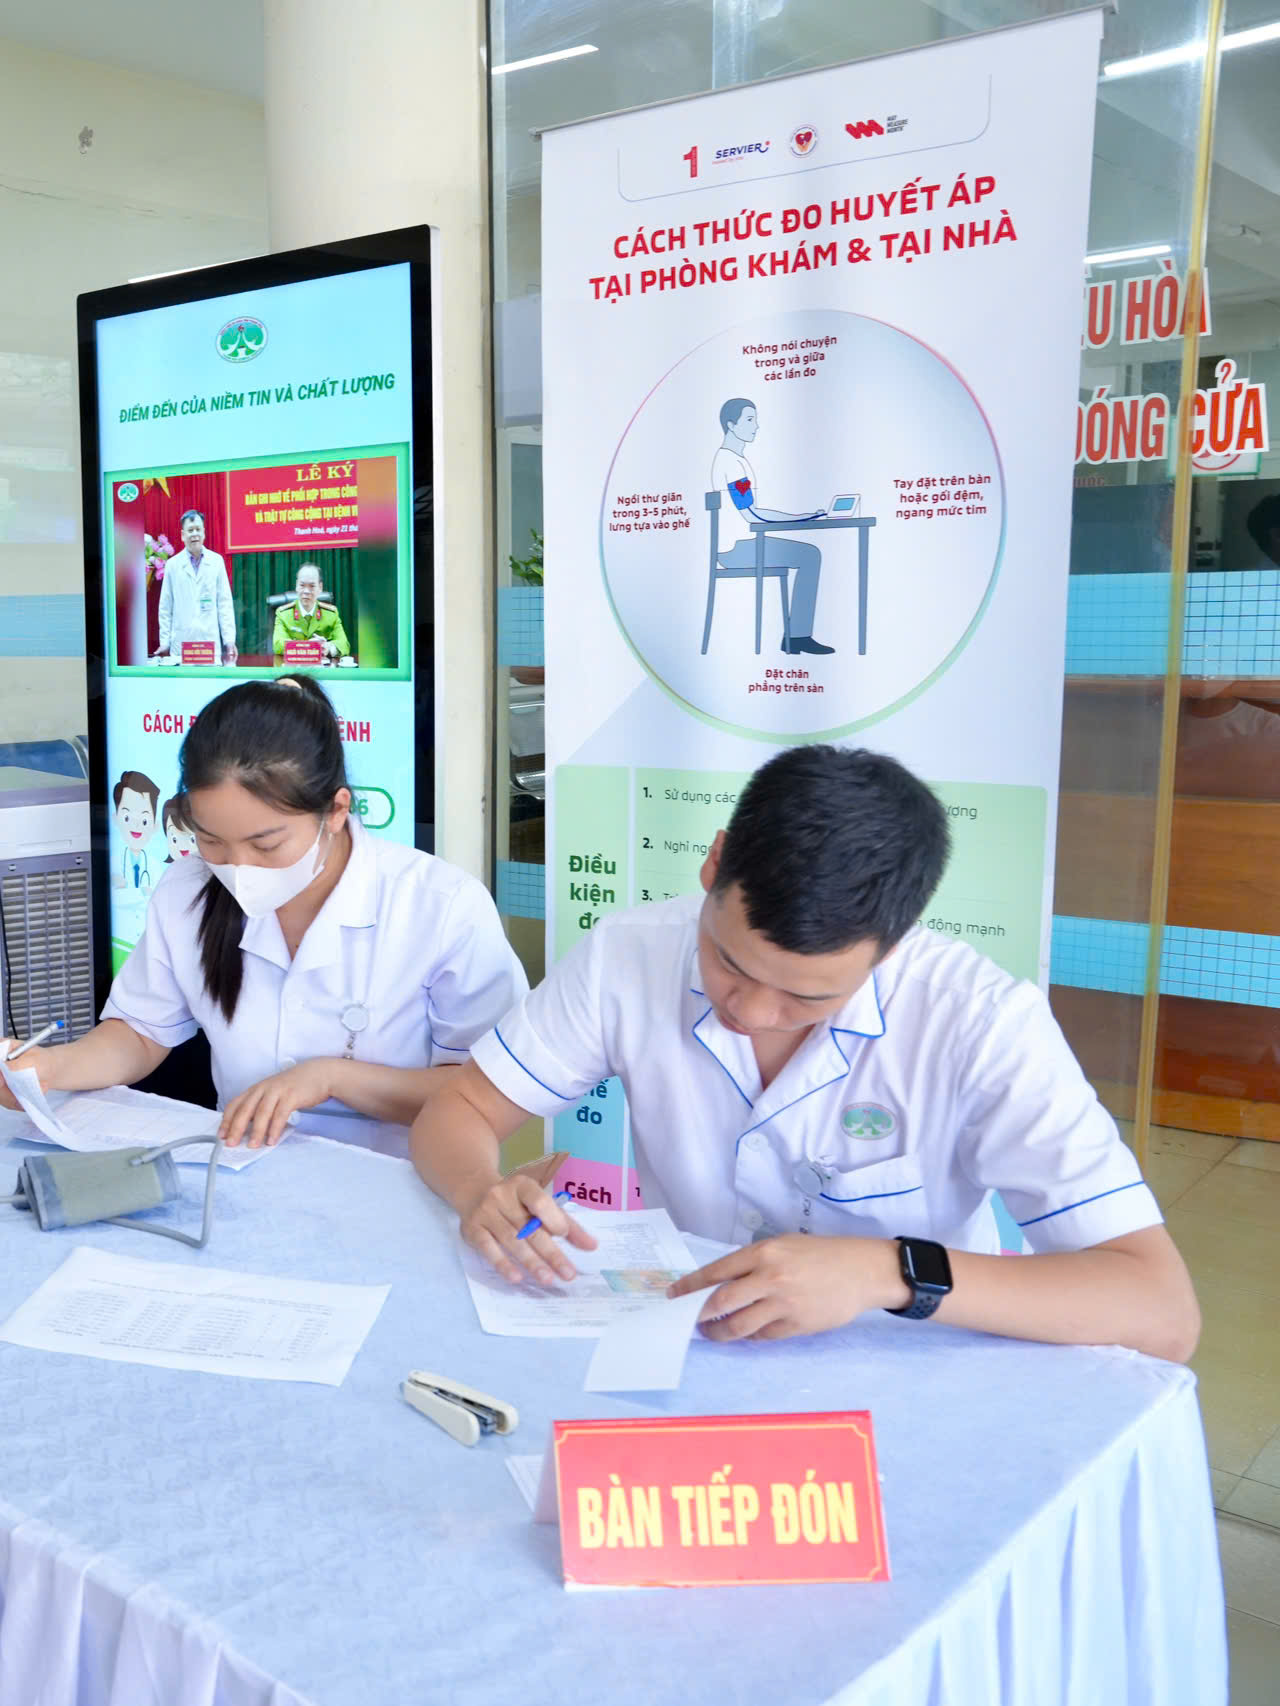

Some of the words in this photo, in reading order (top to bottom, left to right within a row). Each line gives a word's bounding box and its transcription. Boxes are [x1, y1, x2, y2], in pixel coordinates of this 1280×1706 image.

[715, 142, 770, 160] SERVIER
[614, 226, 686, 259] CÁCH
[693, 208, 773, 246] THỨC
[781, 204, 823, 233] ĐO
[830, 177, 941, 225] HUYẾT
[948, 172, 996, 208] ÁP
[589, 273, 631, 304] TẠI
[641, 257, 738, 294] PHÒNG
[748, 240, 838, 279] KHÁM
[847, 238, 872, 263] &
[880, 228, 932, 263] TẠI
[942, 209, 1018, 251] NHÀ
[1125, 260, 1207, 342] HÒA
[742, 344, 778, 354] Không
[781, 340, 797, 351] nói
[800, 336, 837, 348] chuyện
[754, 358, 785, 367] trong
[788, 355, 800, 364] và
[803, 352, 825, 365] giữa
[764, 371, 782, 381] các
[803, 367, 816, 377] đo
[120, 403, 149, 423] ĐIỂM
[152, 399, 177, 419] ĐẾN
[181, 395, 207, 415] CỦA
[210, 391, 245, 411] NIỀM
[248, 389, 271, 406] TIN
[275, 384, 294, 403] VÀ
[297, 376, 338, 400] CHẤT
[342, 373, 396, 398] LƯỢNG
[1183, 362, 1263, 456] CỬA
[327, 461, 354, 478] KÝ
[894, 480, 913, 490] Tay
[916, 477, 937, 489] đặt
[939, 475, 965, 486] trên
[968, 474, 991, 485] bàn
[642, 494, 660, 503] thư
[661, 492, 682, 504] giãn
[900, 493, 928, 504] hoặc
[932, 490, 950, 504] gối
[953, 490, 984, 502] đệm,
[613, 510, 640, 519] trong
[642, 507, 658, 516] 3-5
[661, 506, 687, 517] phút,
[896, 508, 933, 520] ngang
[937, 505, 963, 516] mức
[966, 504, 987, 515] tim
[609, 522, 631, 532] lưng
[634, 522, 650, 532] tựa
[652, 520, 670, 530] vào
[672, 518, 691, 530] ghế
[765, 669, 784, 680] Đặt
[786, 669, 809, 679] chân
[748, 680, 782, 694] phẳng
[784, 682, 805, 692] trên
[807, 683, 824, 693] sàn
[143, 709, 184, 734] CÁCH
[643, 787, 653, 799] 1.
[665, 788, 679, 801] Sử
[682, 790, 712, 805] dụng
[715, 791, 737, 804] các
[643, 837, 654, 849] 2.
[664, 840, 690, 854] Nghỉ
[569, 853, 617, 875] Điều
[570, 883, 615, 907] kiện
[642, 889, 653, 901] 3.
[927, 918, 962, 935] động
[966, 922, 1006, 937] mạnh
[576, 1105, 602, 1125] đo
[564, 1181, 612, 1206] Cách
[577, 1474, 664, 1549] BÀN
[671, 1464, 760, 1547] TIẾP
[770, 1469, 859, 1545] ĐÓN
